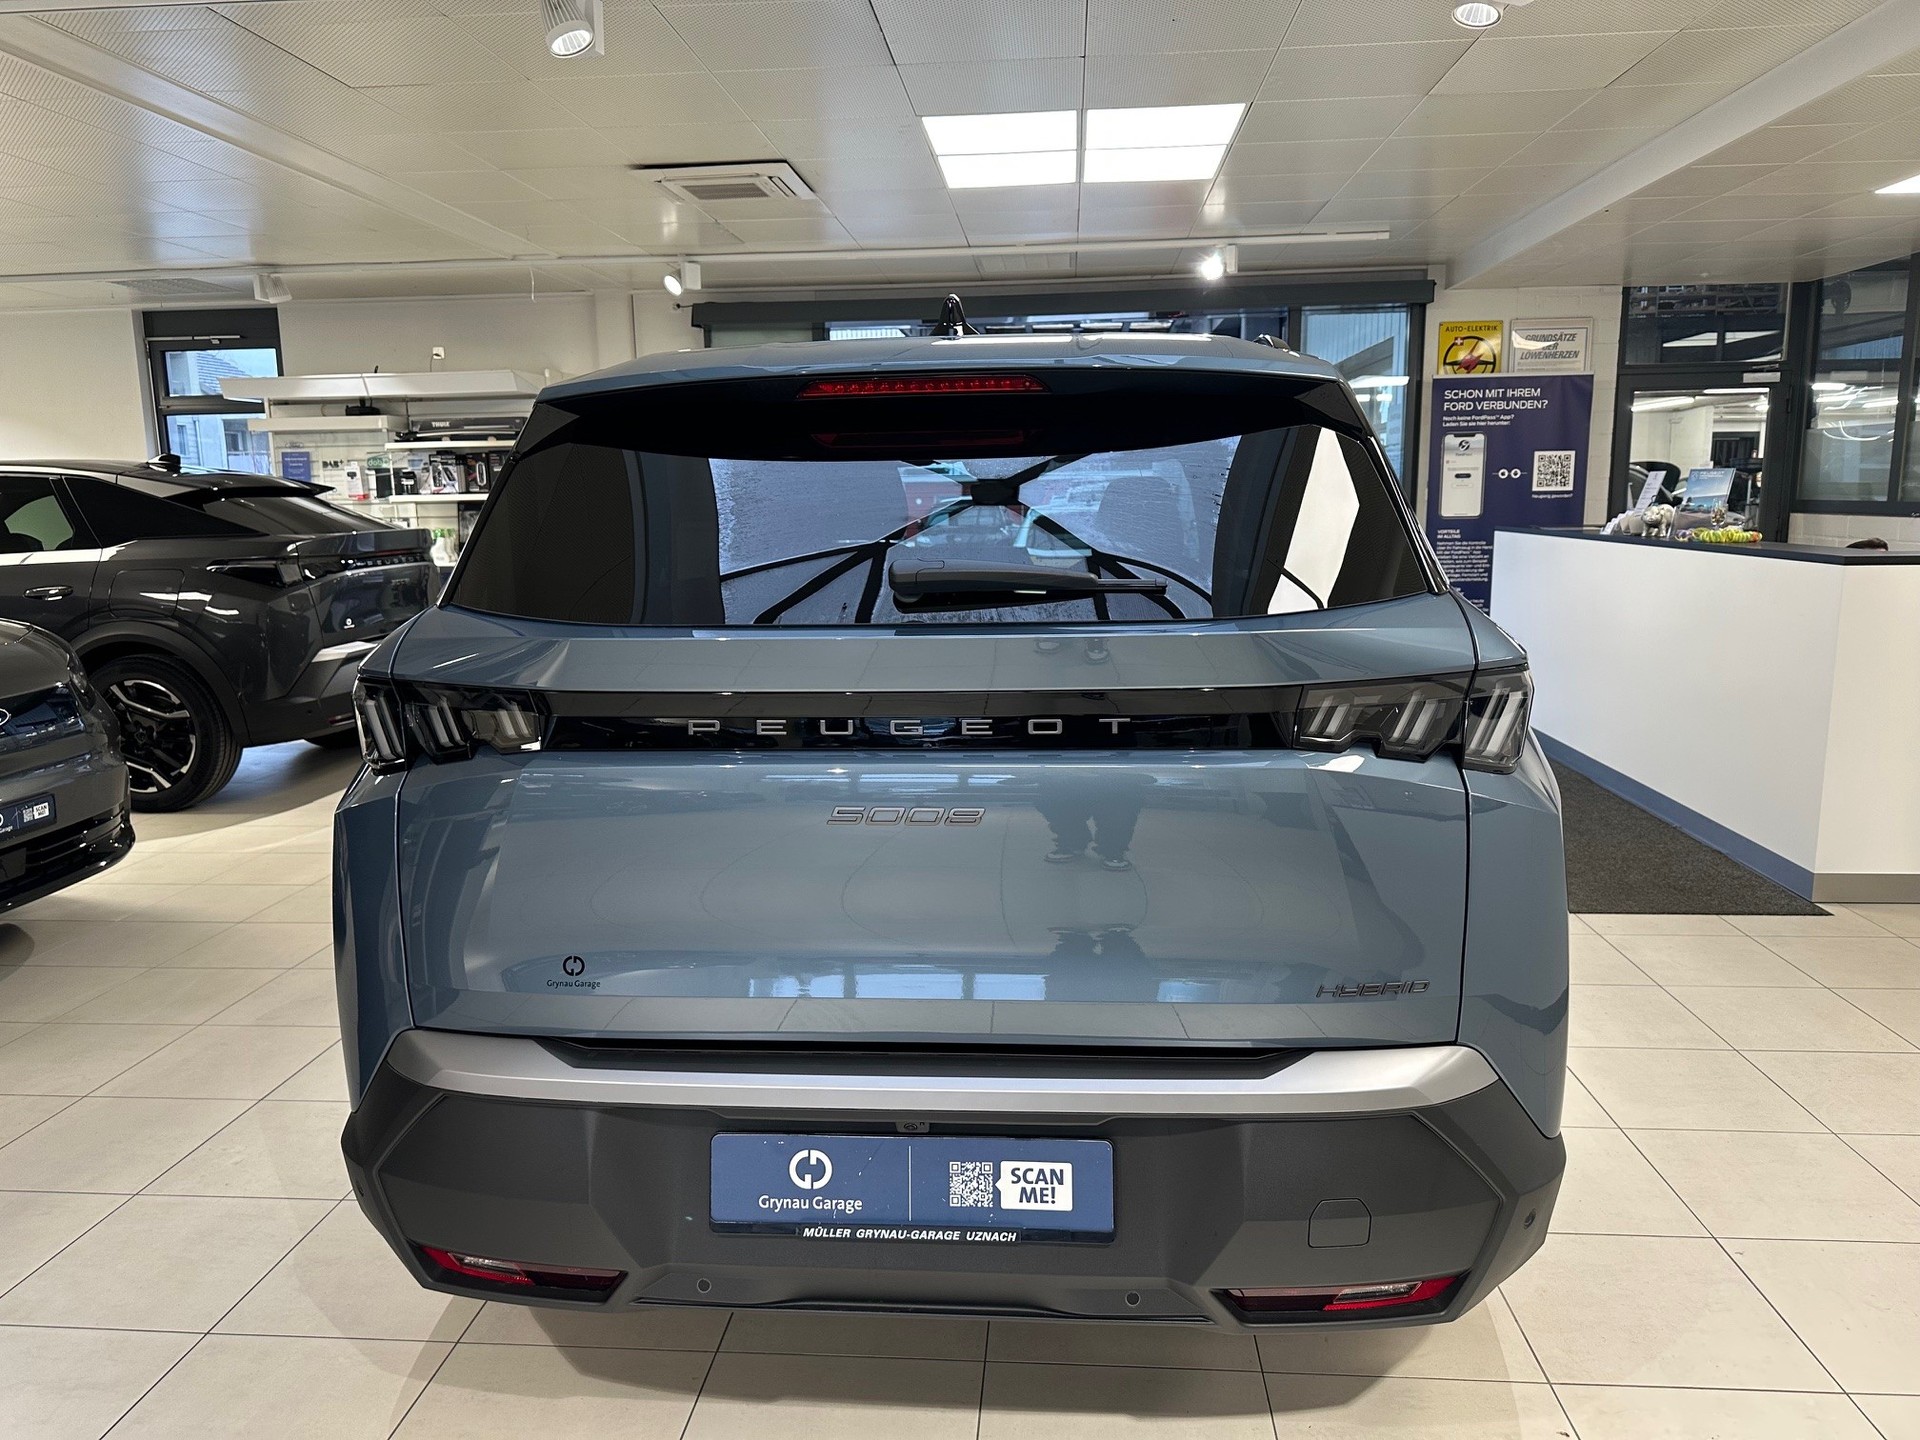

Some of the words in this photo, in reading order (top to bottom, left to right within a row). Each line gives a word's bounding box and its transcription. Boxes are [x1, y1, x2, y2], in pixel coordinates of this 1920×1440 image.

[1445, 325, 1499, 333] AUTO-ELEKTRIK
[1444, 389, 1483, 400] SCHON
[1485, 389, 1505, 398] MIT
[1506, 388, 1541, 398] IHREM
[1443, 402, 1474, 411] FORD
[1475, 400, 1549, 410] VERBUNDEN?
[1500, 413, 1515, 421] App?
[687, 718, 1132, 735] PEUGEOT
[826, 805, 986, 827] 5008
[546, 979, 574, 990] Grynau
[574, 980, 601, 990] Garage
[1315, 980, 1431, 998] HYBRID
[1010, 1167, 1065, 1186] SCAN
[1018, 1186, 1057, 1205] ME!
[758, 1194, 810, 1213] Grynau
[812, 1195, 863, 1214] Garage
[802, 1226, 852, 1238] MÜLLER
[856, 1227, 961, 1241] GRYNAU-GARAGE
[966, 1231, 1017, 1242] UZNACH
